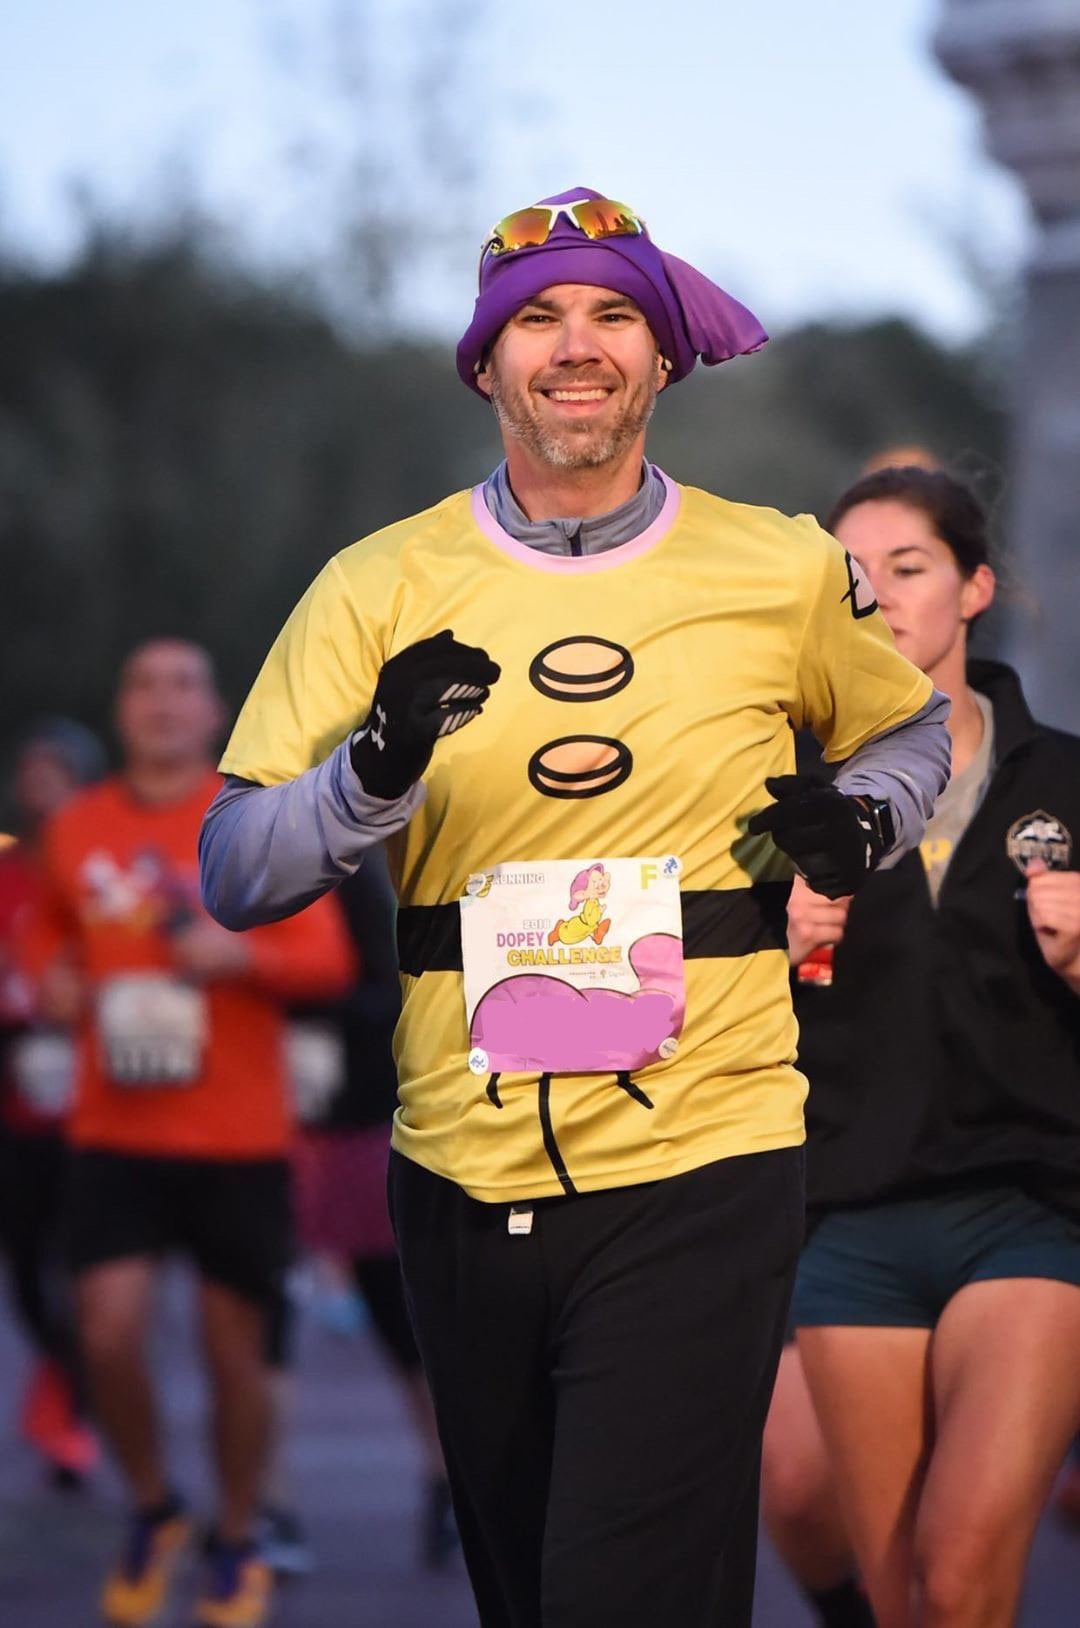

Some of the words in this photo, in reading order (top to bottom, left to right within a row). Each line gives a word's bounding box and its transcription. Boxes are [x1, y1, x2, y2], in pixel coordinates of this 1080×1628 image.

[641, 864, 657, 890] F
[496, 931, 545, 947] DOPEY
[506, 945, 622, 967] CHALLENGE
